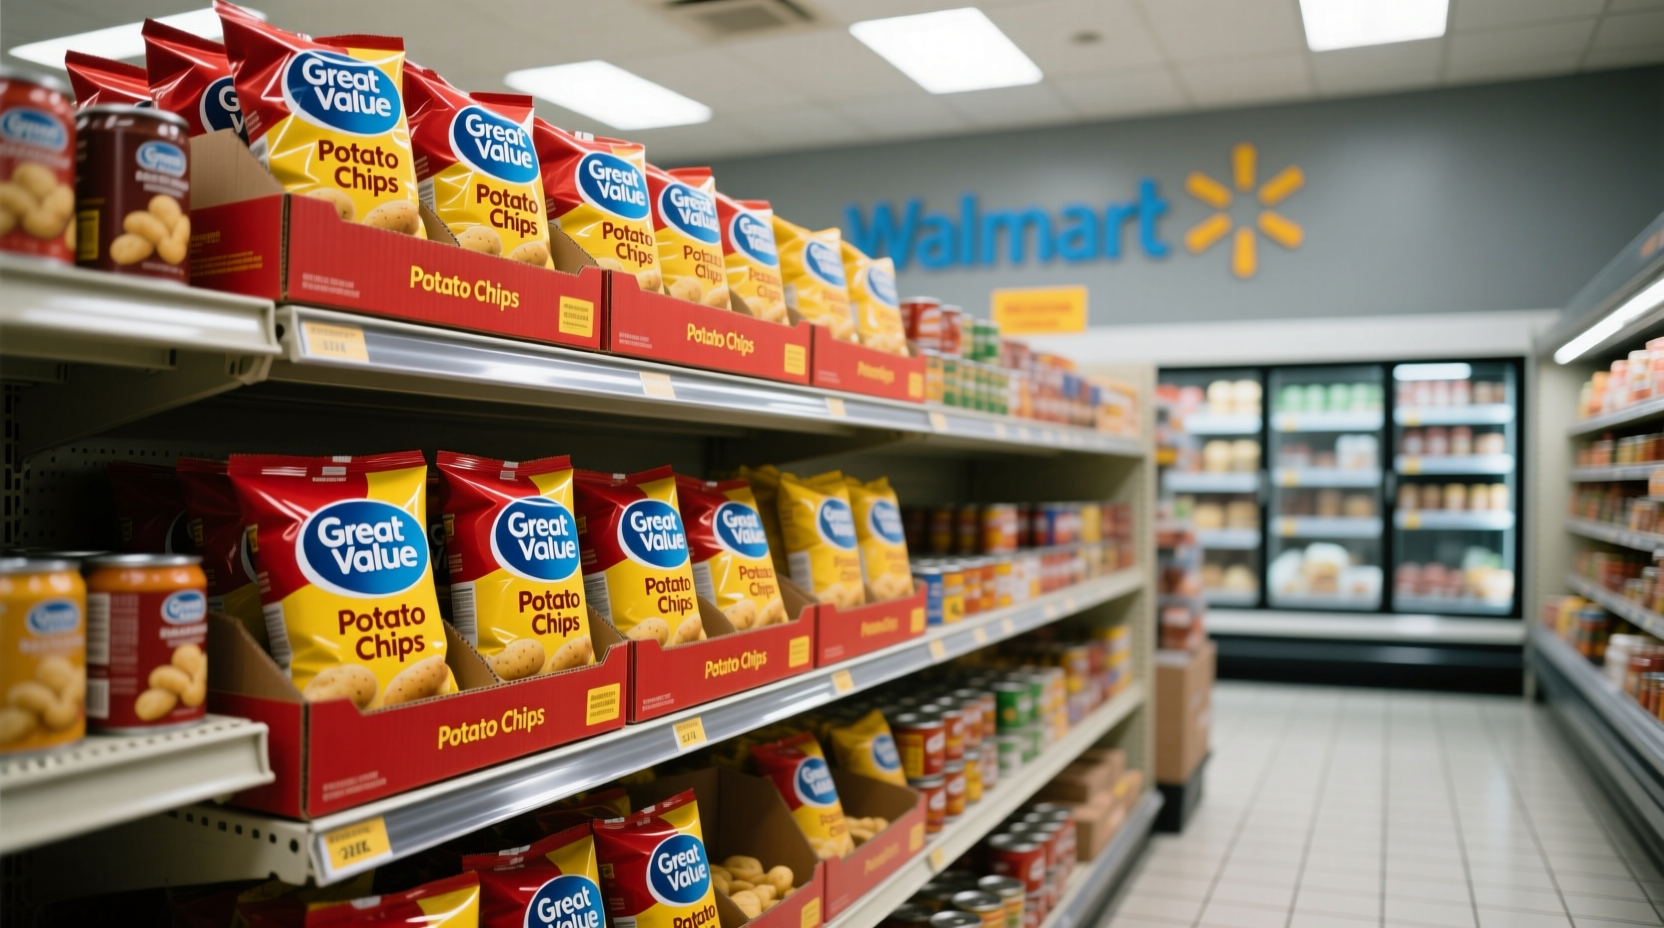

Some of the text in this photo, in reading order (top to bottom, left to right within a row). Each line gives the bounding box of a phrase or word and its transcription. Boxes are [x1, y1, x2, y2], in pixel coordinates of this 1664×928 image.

[302, 58, 380, 93] Great
[314, 87, 391, 117] Value
[465, 114, 526, 147] Great
[318, 139, 399, 169] Potato
[475, 139, 533, 169] Value
[334, 166, 399, 196] Chips
[588, 159, 638, 186] Great
[476, 184, 538, 214] Potato
[597, 180, 645, 207] Value
[490, 209, 538, 238] Chips
[602, 221, 653, 247] Potato
[845, 177, 1168, 271] Walmart
[615, 243, 653, 268] Chips
[410, 265, 519, 311] Potato Chips
[687, 323, 754, 356] Potato Chips
[318, 515, 404, 548] Great
[508, 511, 568, 538] Great
[630, 511, 677, 533] Great
[518, 537, 576, 561] Value
[639, 530, 685, 551] Value
[331, 543, 418, 574] Value
[519, 590, 580, 613] Potato
[645, 577, 691, 596] Potato
[338, 604, 425, 635] Potato
[658, 596, 693, 616] Chips
[532, 613, 580, 637] Chips
[355, 632, 425, 662] Chips
[705, 649, 767, 679] Potato Chips
[438, 707, 545, 749] Potato Chips
[658, 844, 700, 874] Great
[667, 864, 707, 891] Value
[537, 886, 592, 923] Great
